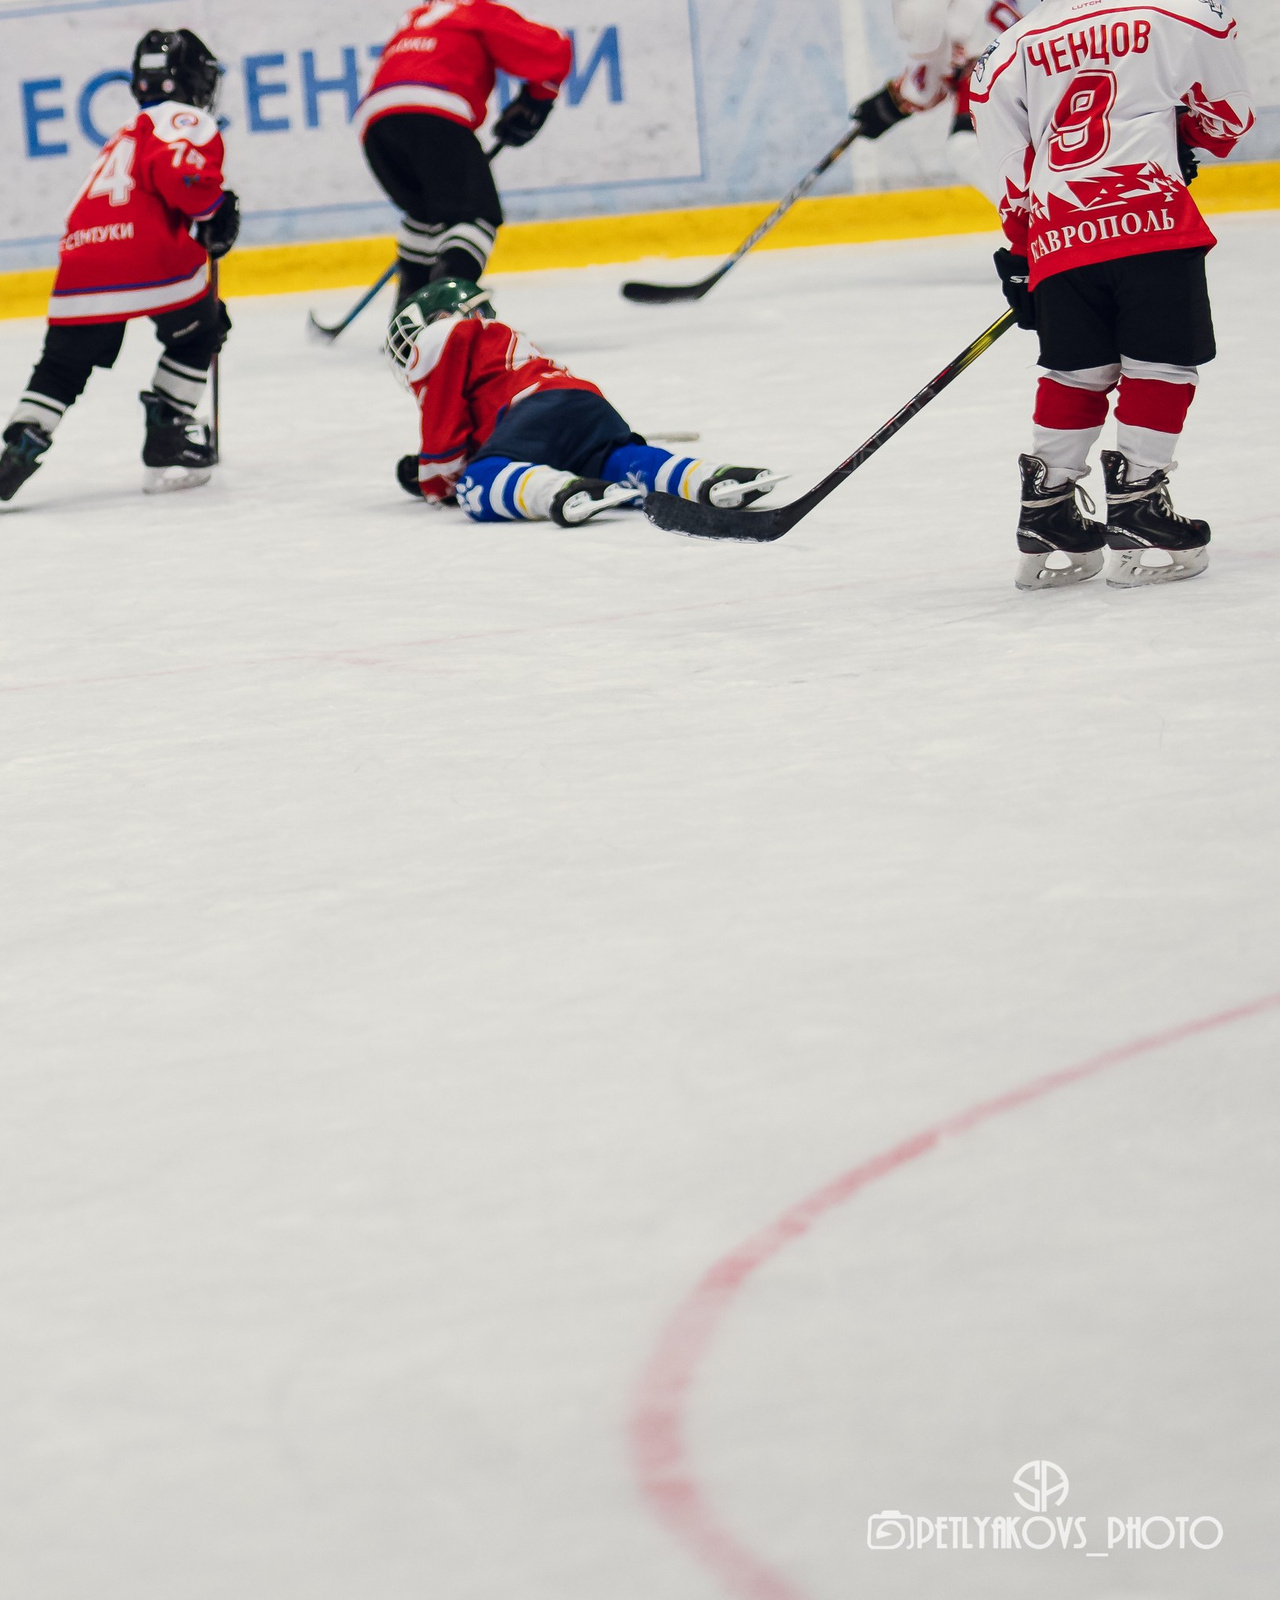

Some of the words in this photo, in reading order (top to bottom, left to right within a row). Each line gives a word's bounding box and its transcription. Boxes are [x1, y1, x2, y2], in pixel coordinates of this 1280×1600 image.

[1071, 0, 1102, 11] LUTCH
[1027, 20, 1151, 77] ЧЕНЦОВ
[1048, 69, 1118, 172] 9
